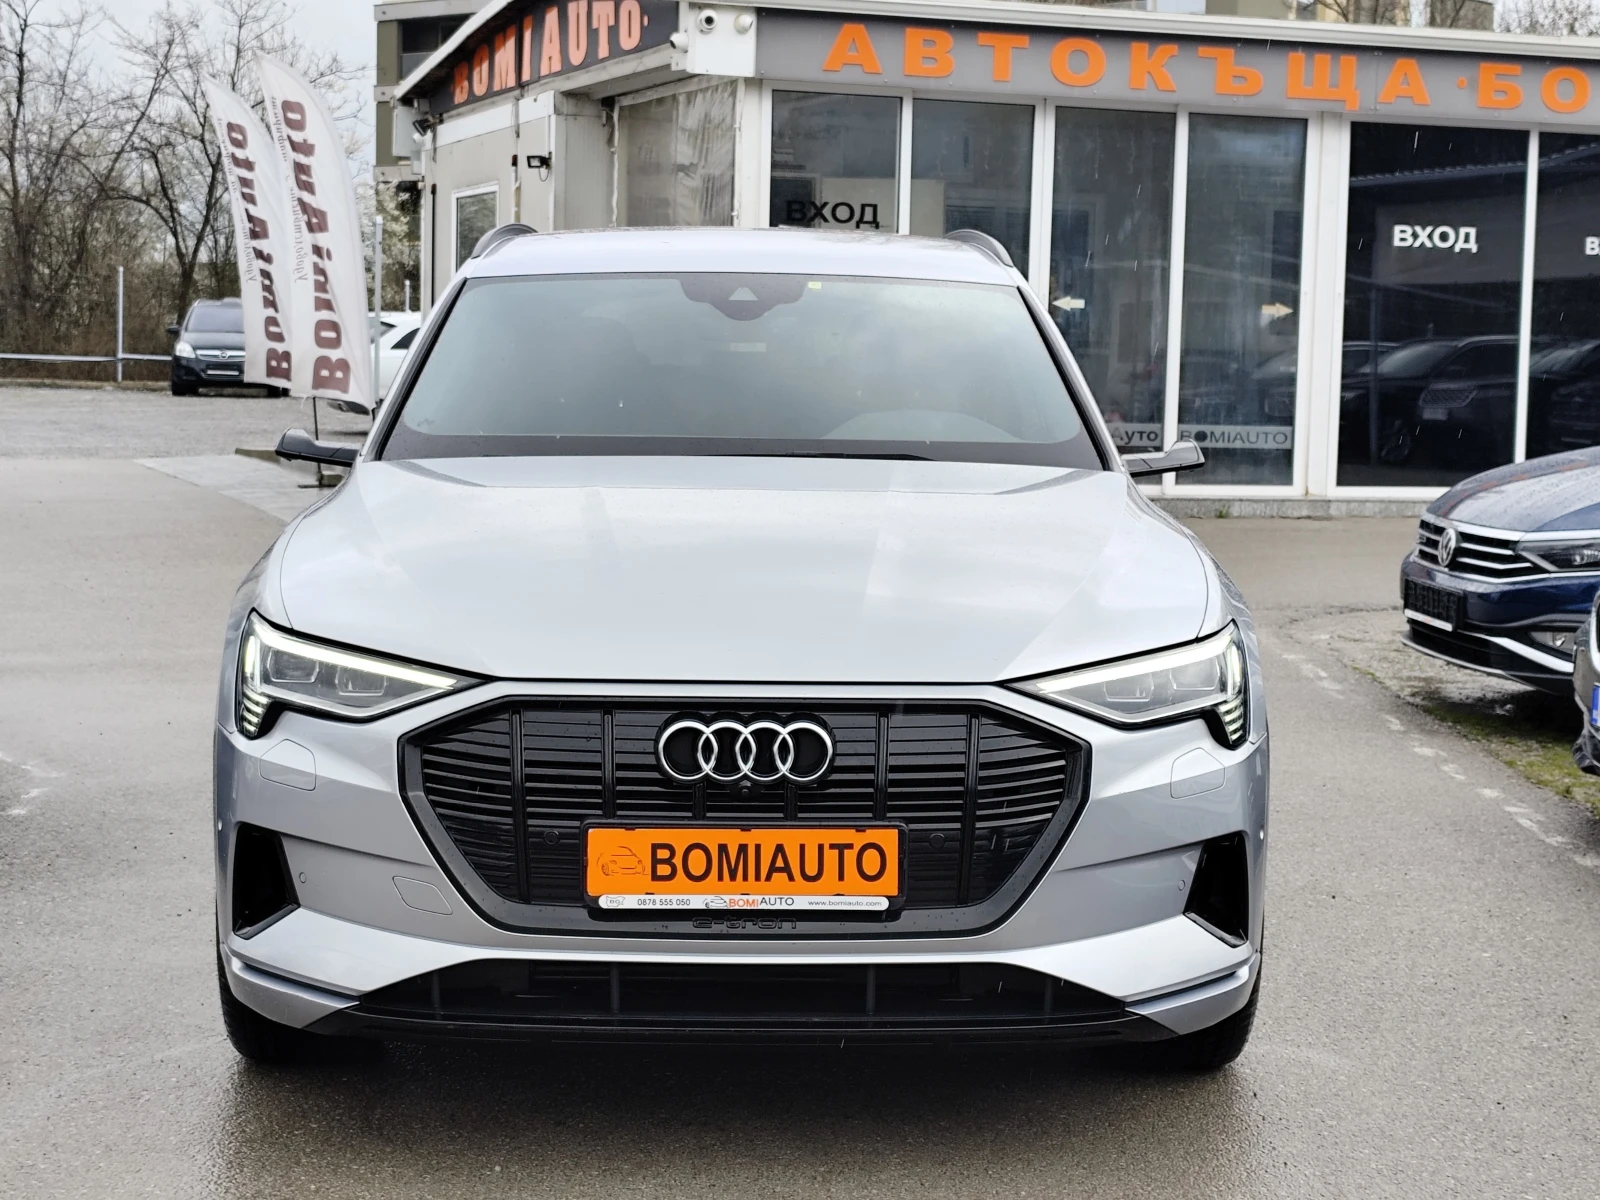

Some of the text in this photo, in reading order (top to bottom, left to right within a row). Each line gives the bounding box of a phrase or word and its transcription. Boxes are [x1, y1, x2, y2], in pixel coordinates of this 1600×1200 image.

[453, 0, 642, 105] BOMIAUTO
[822, 23, 1431, 111] АВТОКЪЩА
[786, 200, 880, 229] ВХОД
[1393, 224, 1478, 253] ВХОД
[1585, 236, 1600, 256] В
[650, 842, 887, 882] BOMIAUTO
[637, 898, 691, 906] 0878 555 050
[807, 899, 882, 907] www.bomiauto.com
[692, 917, 797, 930] e-tron
